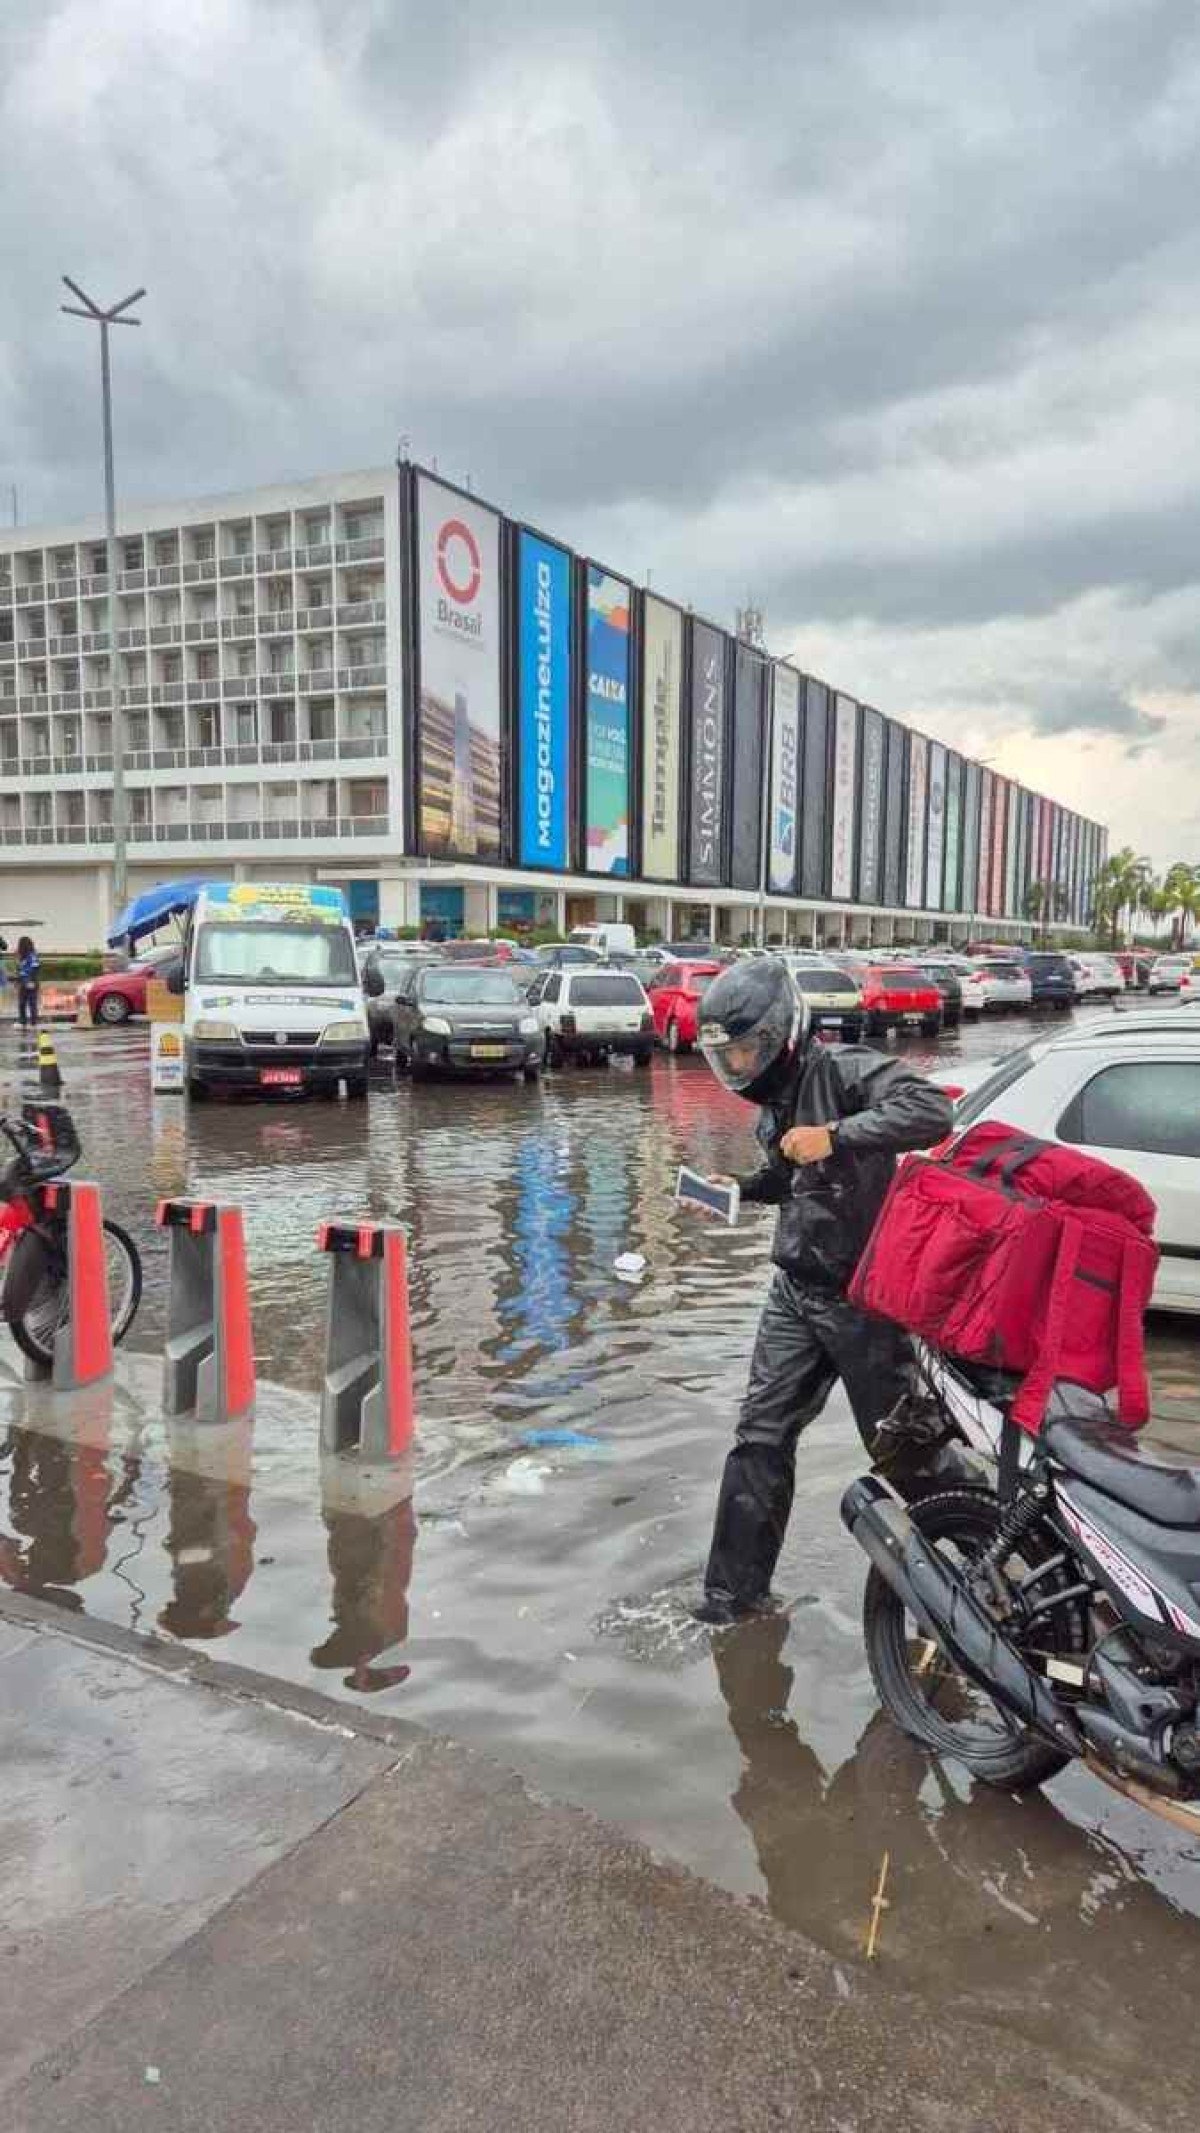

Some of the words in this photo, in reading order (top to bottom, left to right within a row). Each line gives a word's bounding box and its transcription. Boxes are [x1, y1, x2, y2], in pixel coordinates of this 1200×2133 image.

[589, 672, 626, 702] CAIXA
[700, 659, 717, 864] SIMMONS
[781, 723, 795, 808] BRB
